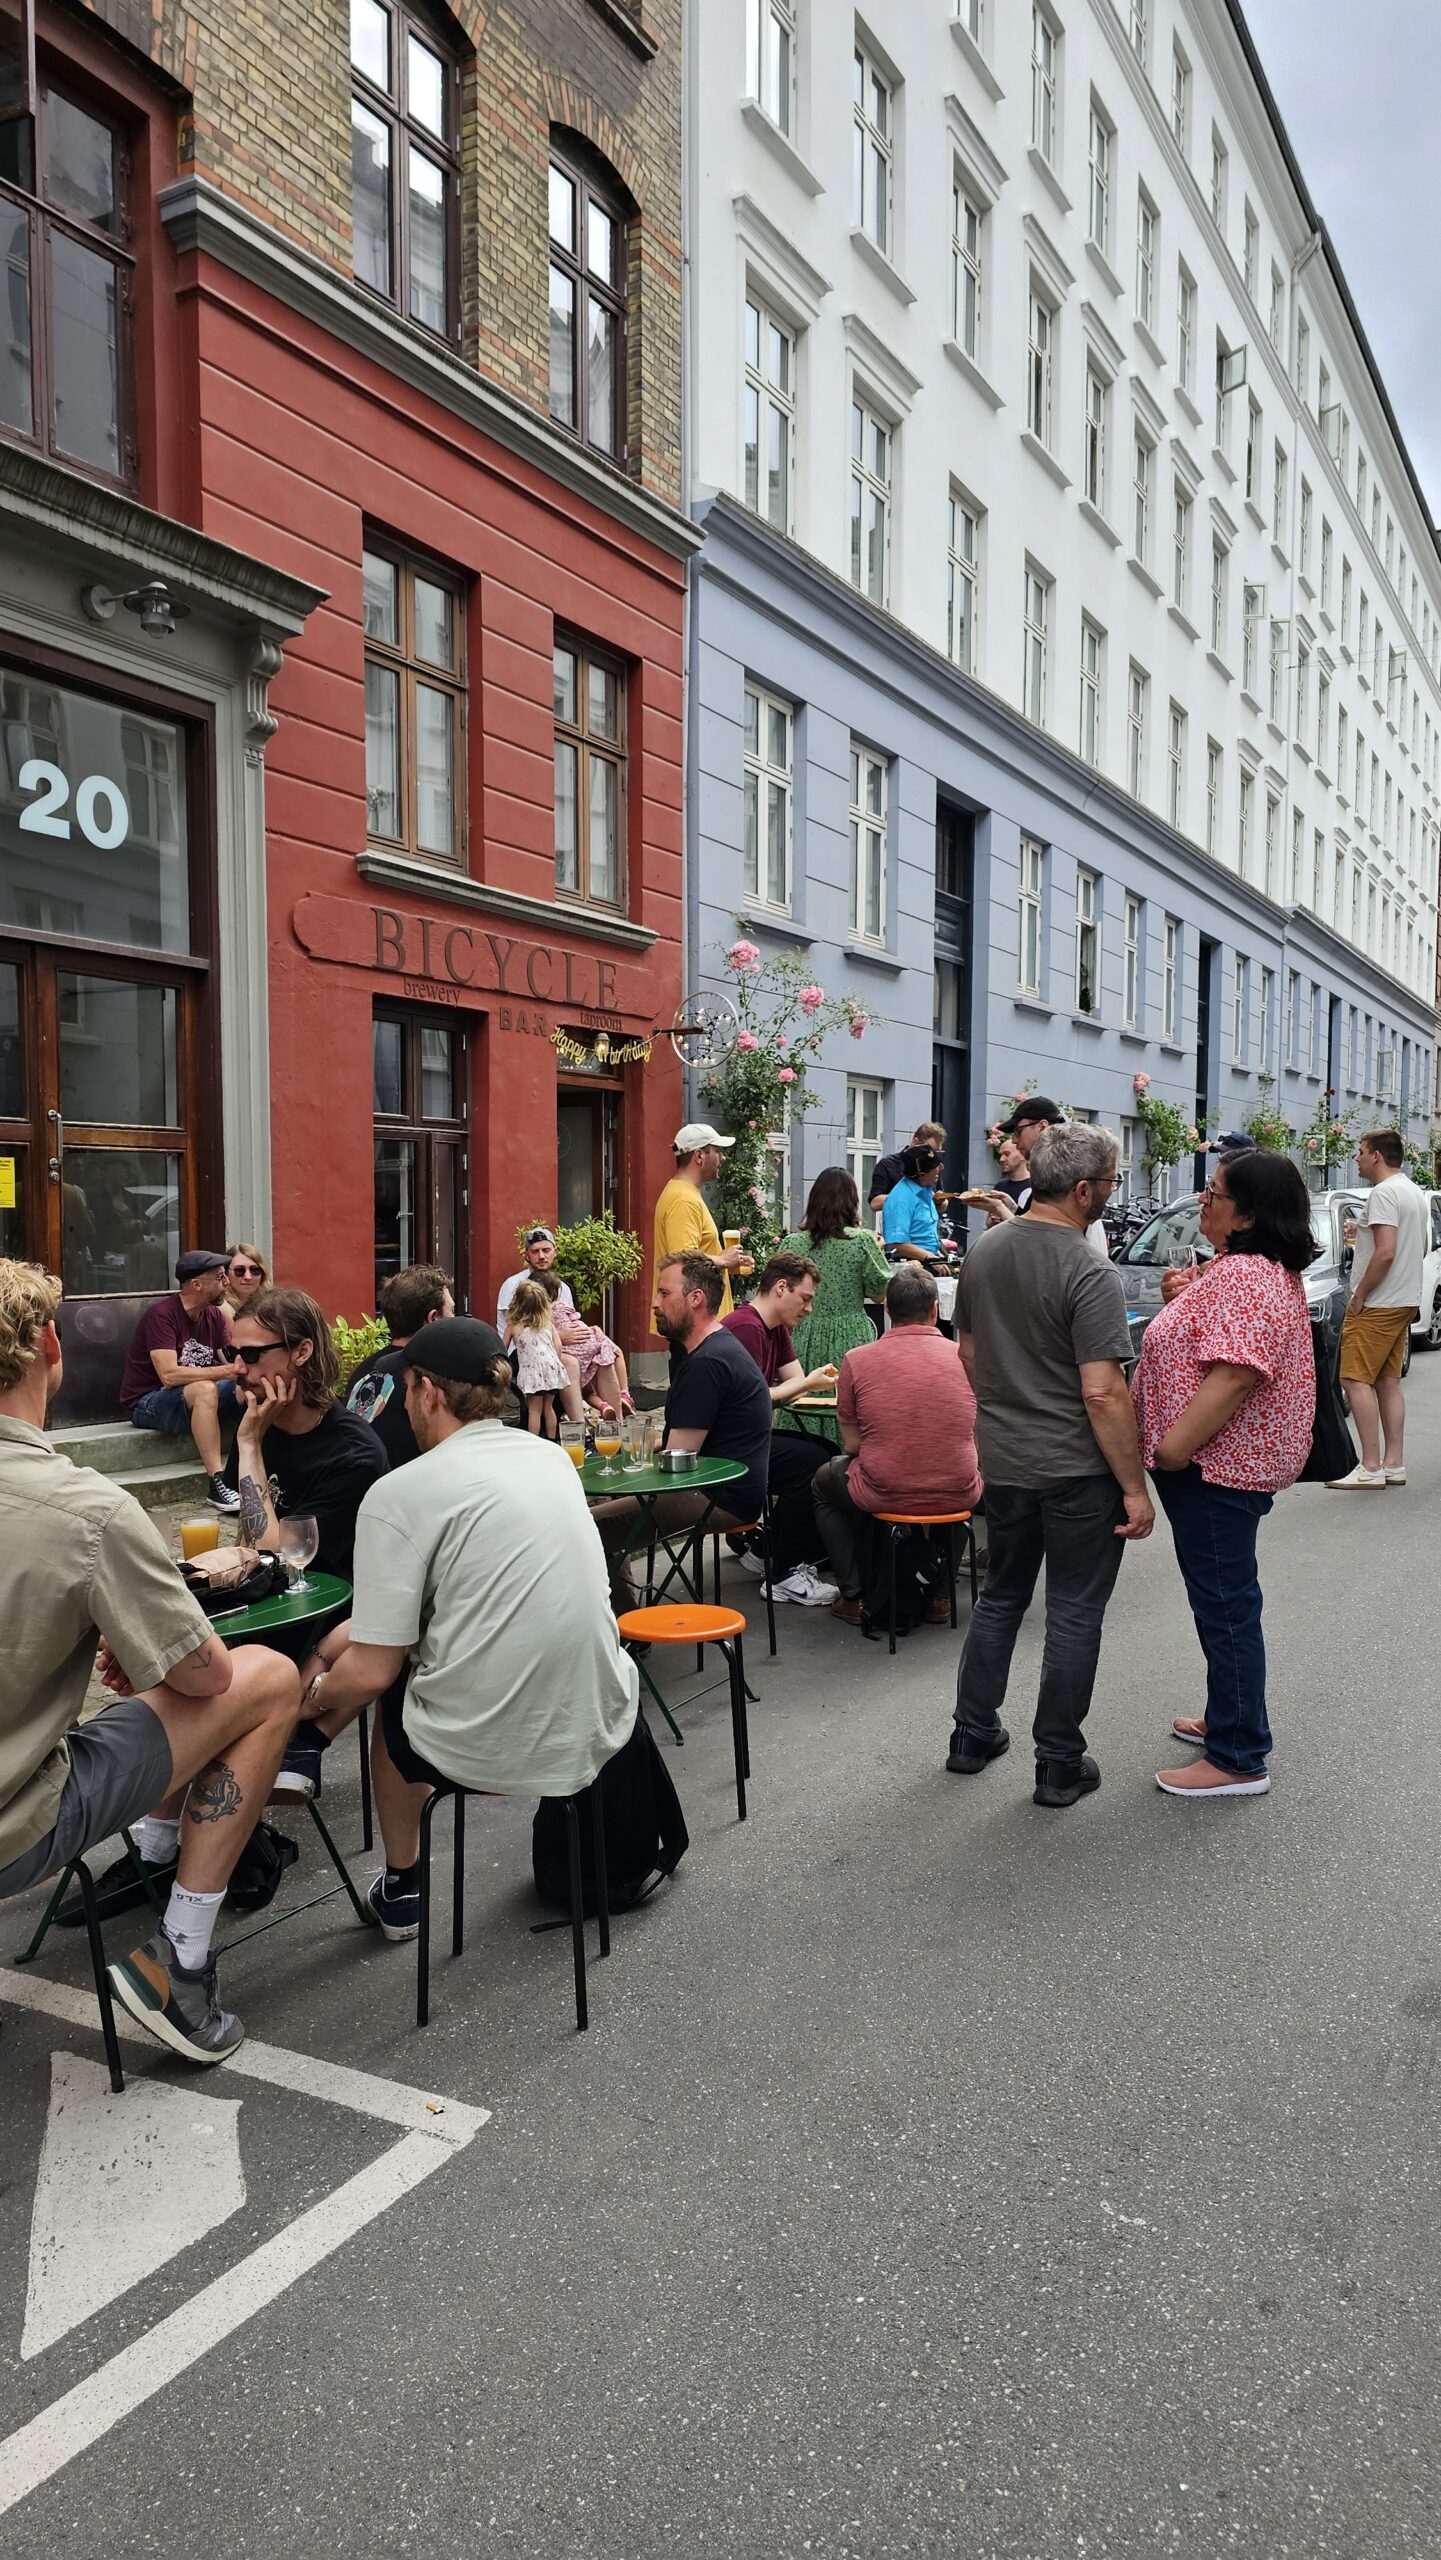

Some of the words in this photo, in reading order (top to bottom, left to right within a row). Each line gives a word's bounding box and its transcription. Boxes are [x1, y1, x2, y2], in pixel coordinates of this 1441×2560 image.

[19, 759, 129, 850] 20
[371, 907, 620, 1011] BICYCLE
[403, 975, 461, 1007] brewery
[499, 1006, 548, 1038] BAR
[580, 1011, 623, 1031] taproom
[549, 1025, 588, 1065] Happy
